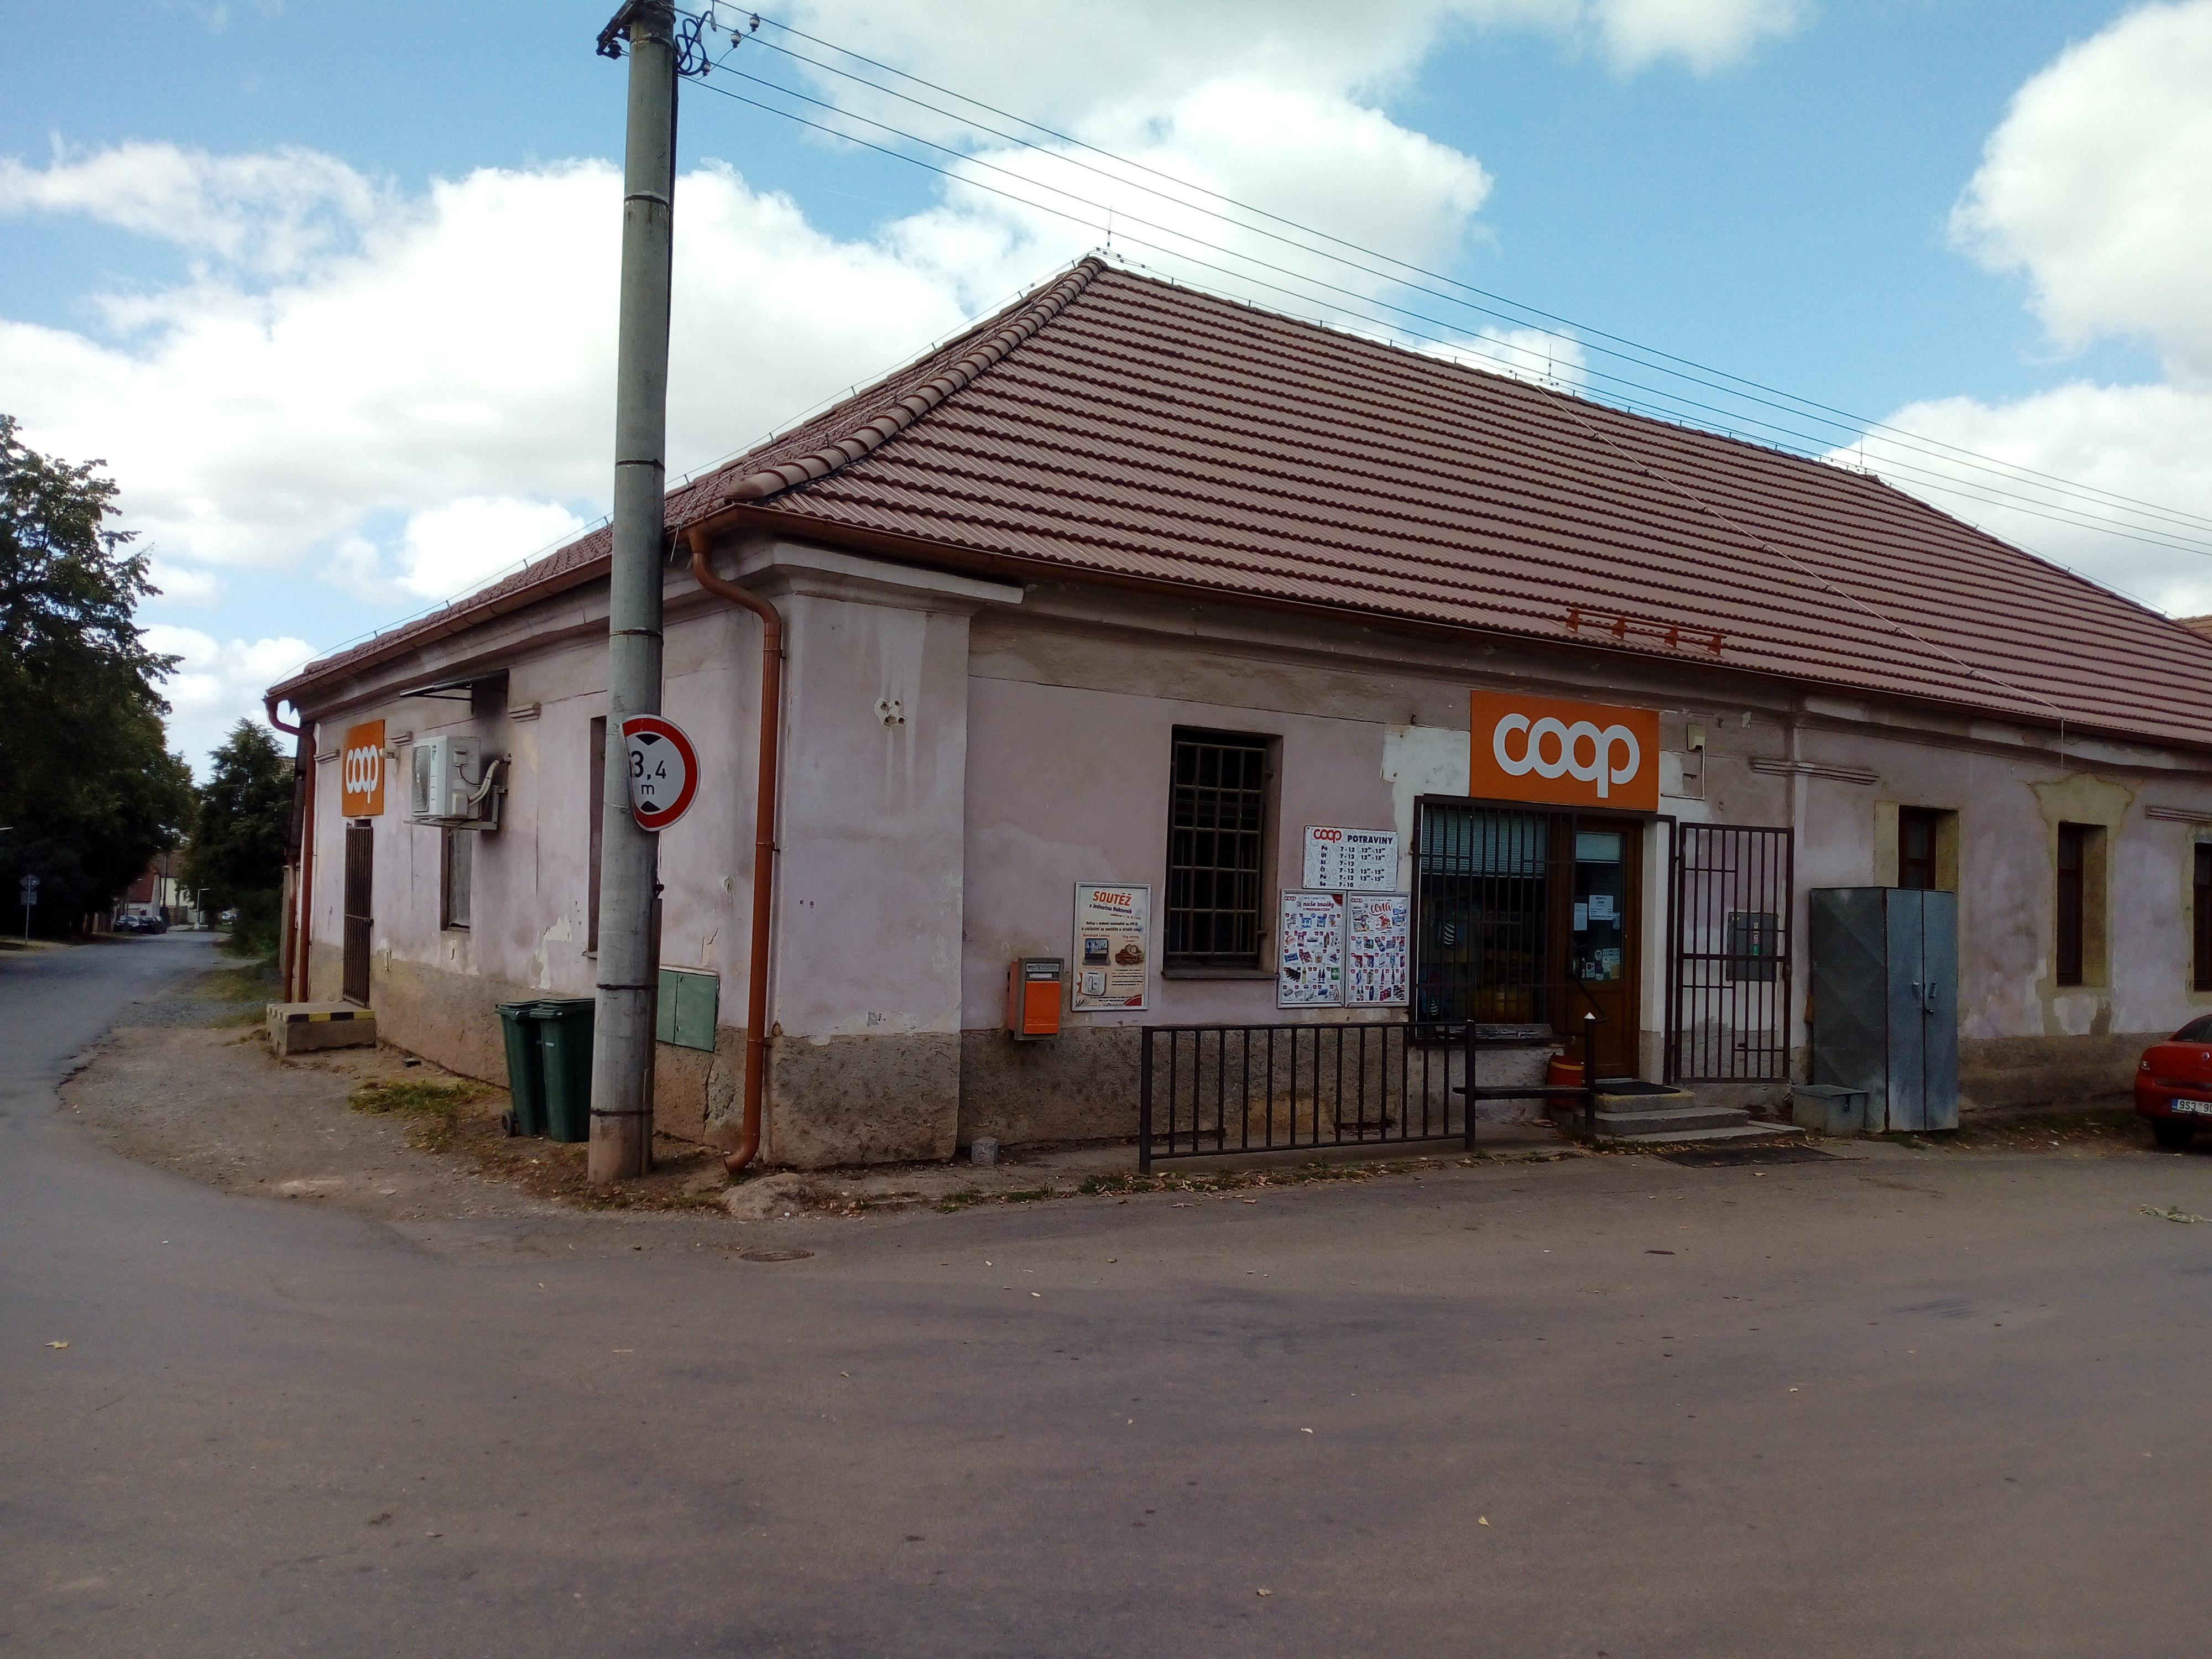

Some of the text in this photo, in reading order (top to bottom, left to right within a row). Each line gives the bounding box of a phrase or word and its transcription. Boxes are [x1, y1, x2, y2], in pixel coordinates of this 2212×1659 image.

[1493, 713, 1640, 799] coop
[346, 744, 379, 804] coop
[630, 750, 666, 781] 3,4
[641, 784, 655, 795] m
[1313, 828, 1393, 845] coop POTRAVINY
[1093, 891, 1133, 906] SOUTĚŽ
[2179, 1100, 2196, 1112] 9S3
